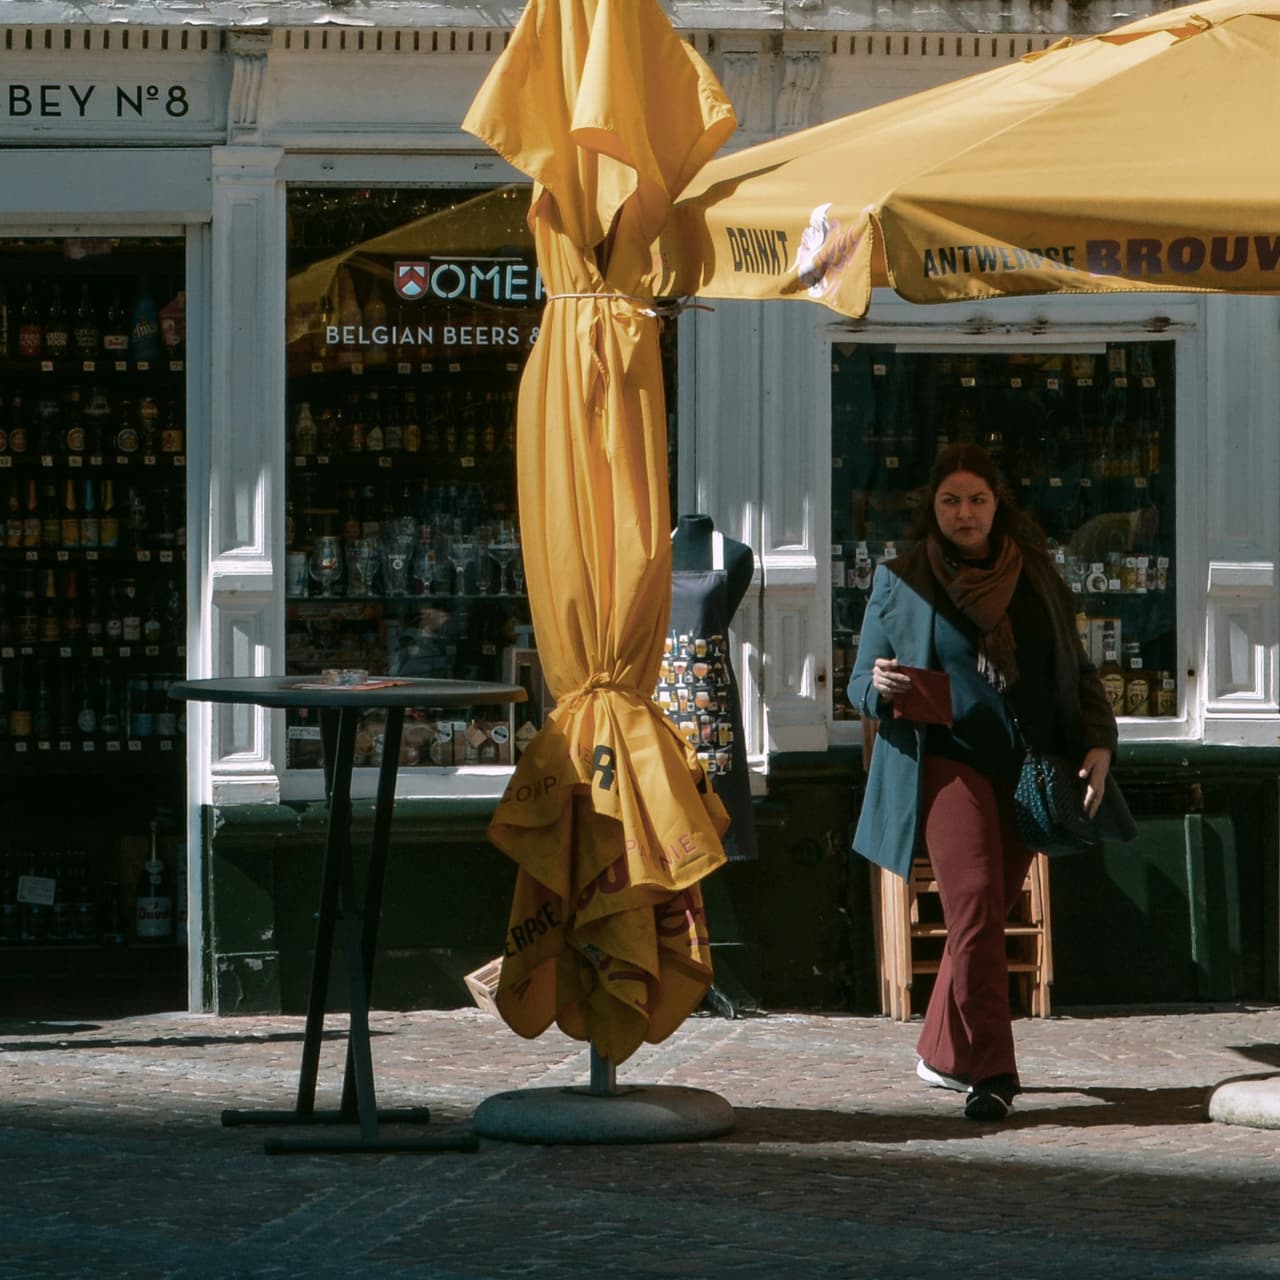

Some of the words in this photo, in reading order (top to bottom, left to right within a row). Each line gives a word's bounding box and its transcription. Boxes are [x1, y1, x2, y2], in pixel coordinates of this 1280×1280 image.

[725, 226, 789, 276] DRINKT
[923, 240, 1079, 278] ANTWERPSE
[325, 326, 434, 345] BELGIAN
[443, 326, 520, 345] BEERS
